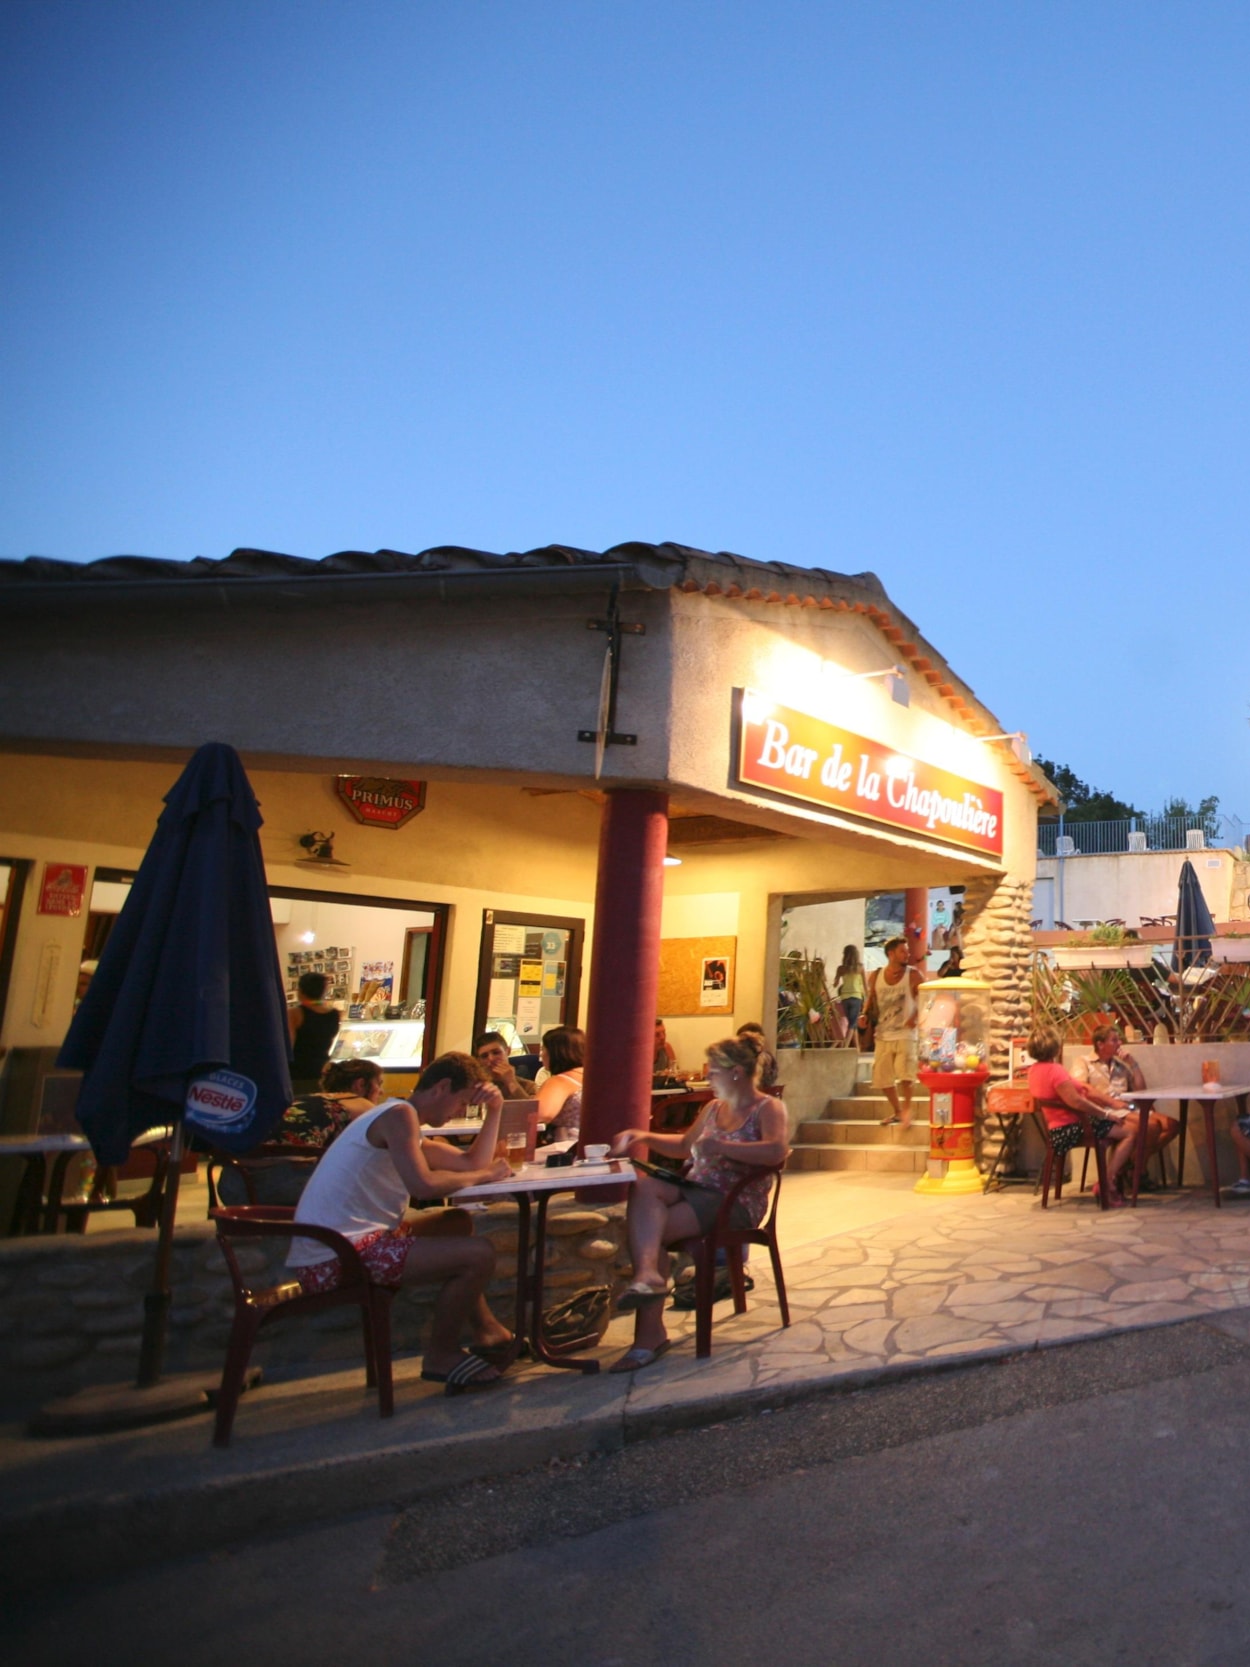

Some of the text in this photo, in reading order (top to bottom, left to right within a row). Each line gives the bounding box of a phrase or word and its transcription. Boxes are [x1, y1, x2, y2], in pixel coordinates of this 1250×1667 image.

[757, 719, 998, 838] Bar de la Chapoulière
[352, 790, 413, 810] PRIMUS
[190, 1086, 246, 1112] Nestlé
